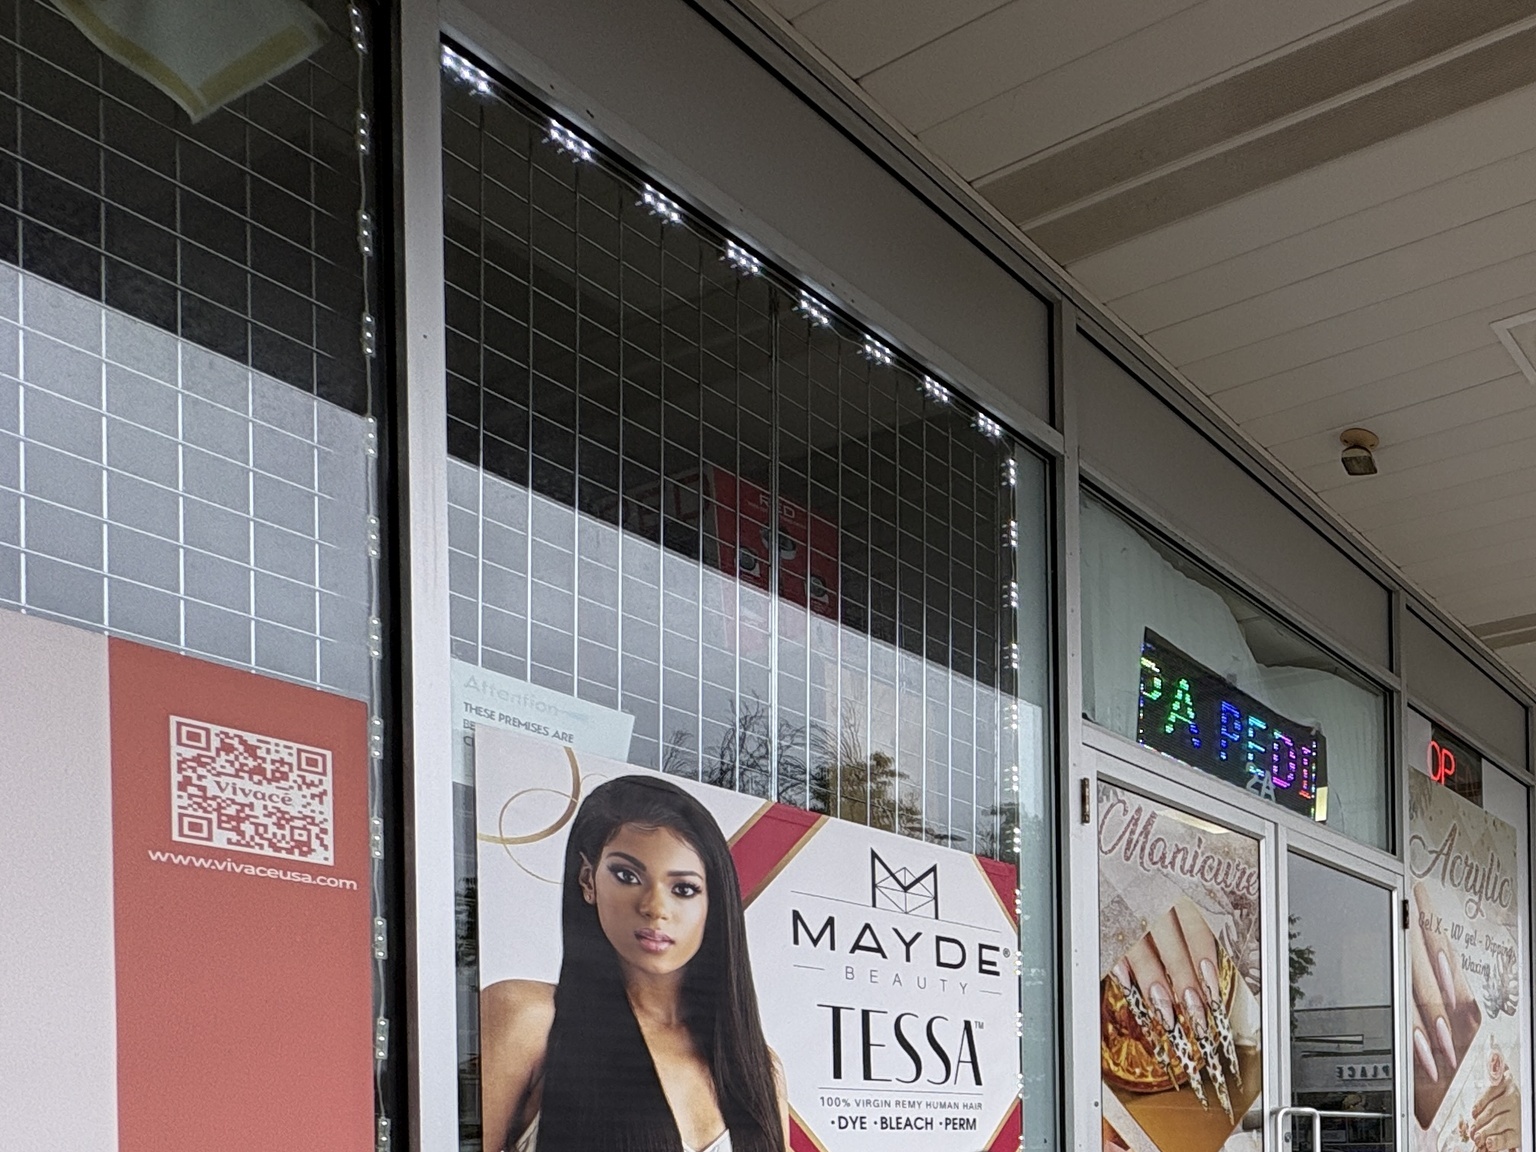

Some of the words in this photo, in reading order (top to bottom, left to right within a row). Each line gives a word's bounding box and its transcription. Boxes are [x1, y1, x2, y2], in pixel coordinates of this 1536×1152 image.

[463, 701, 496, 721] THESE
[498, 712, 550, 737] PREMISES
[551, 730, 575, 744] ARE
[1099, 797, 1259, 896] Manicure
[148, 849, 358, 891] www.vivaceusa.com
[1409, 822, 1512, 921] Acrylic
[1434, 916, 1443, 935] X
[845, 965, 968, 995] BEAUTY
[819, 1096, 851, 1107] 100%
[854, 1098, 892, 1109] VIRGIN
[895, 1100, 922, 1110] REMY
[925, 1101, 960, 1110] HUMAN
[962, 1102, 983, 1111] HAIR
